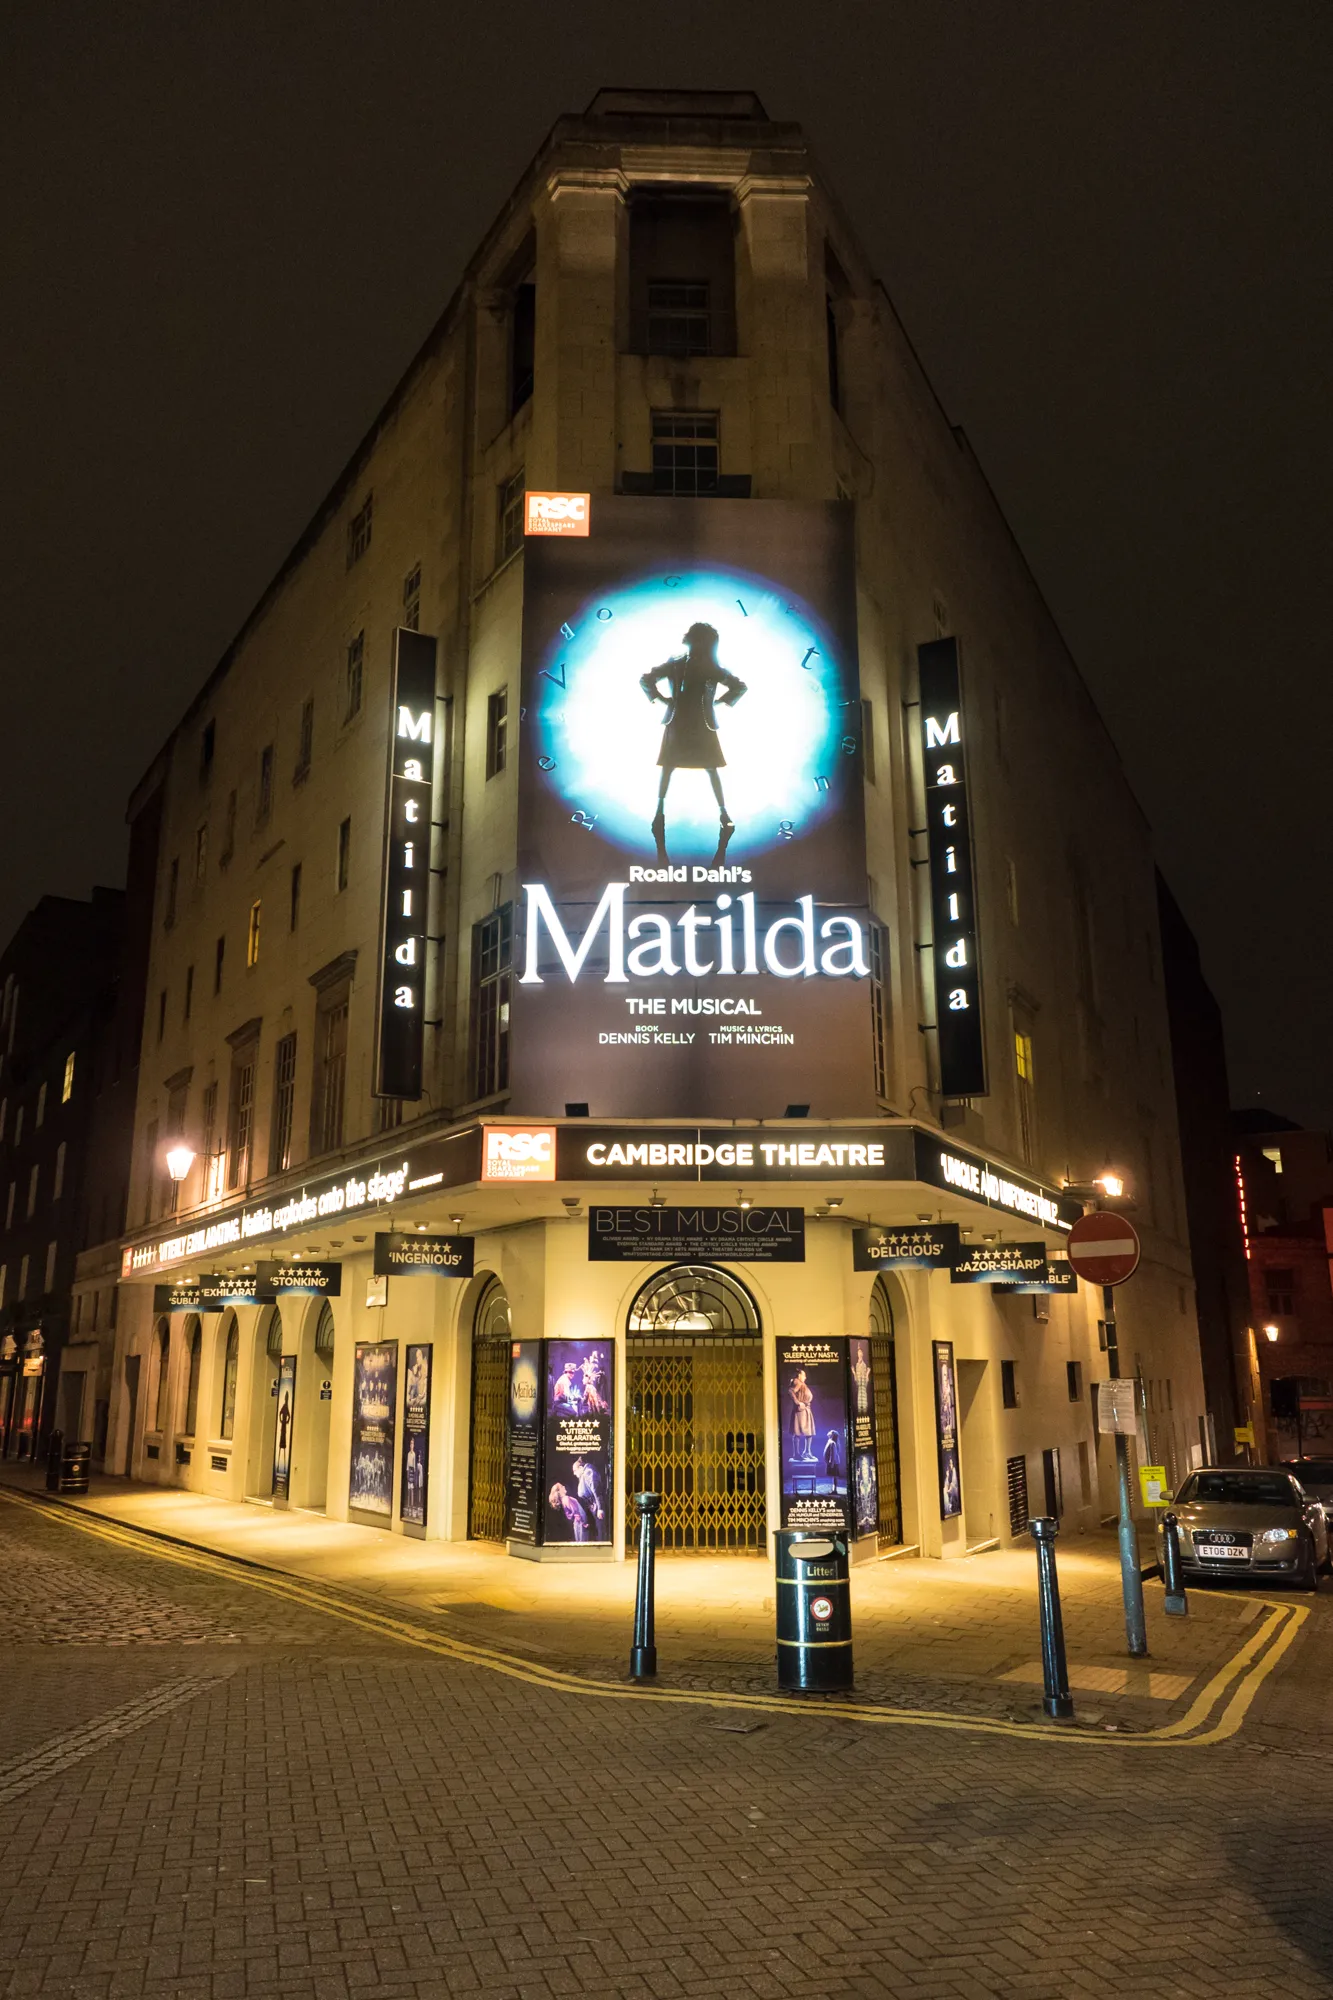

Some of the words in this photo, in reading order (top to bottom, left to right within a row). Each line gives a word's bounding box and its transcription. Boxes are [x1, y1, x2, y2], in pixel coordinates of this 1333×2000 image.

[529, 496, 584, 520] RSC
[629, 866, 687, 883] Roald
[692, 866, 752, 883] Dahl's
[518, 882, 872, 985] Matilda
[625, 998, 666, 1015] THE
[671, 998, 762, 1016] MUSICAL
[598, 1033, 650, 1044] DENNIS
[654, 1033, 695, 1044] KELLY
[708, 1033, 732, 1044] TIM
[736, 1033, 794, 1045] MINCHIN
[488, 1133, 550, 1162] RSC
[586, 1143, 754, 1167] CAMBRIDGE
[759, 1143, 885, 1166] THEATRE
[981, 1171, 999, 1202] AND
[273, 1194, 317, 1231] explodes
[318, 1186, 345, 1217] onto
[345, 1178, 367, 1208] the
[596, 1210, 668, 1232] BEST
[677, 1210, 802, 1233] MUSICAL
[388, 1252, 462, 1266] 'INGENIOUS'
[867, 1244, 944, 1258] 'DELICIOUS'
[270, 1277, 329, 1287] 'STONKING'
[1203, 1547, 1225, 1556] ET06
[1227, 1548, 1245, 1556] DZK
[806, 1566, 834, 1577] Litter
